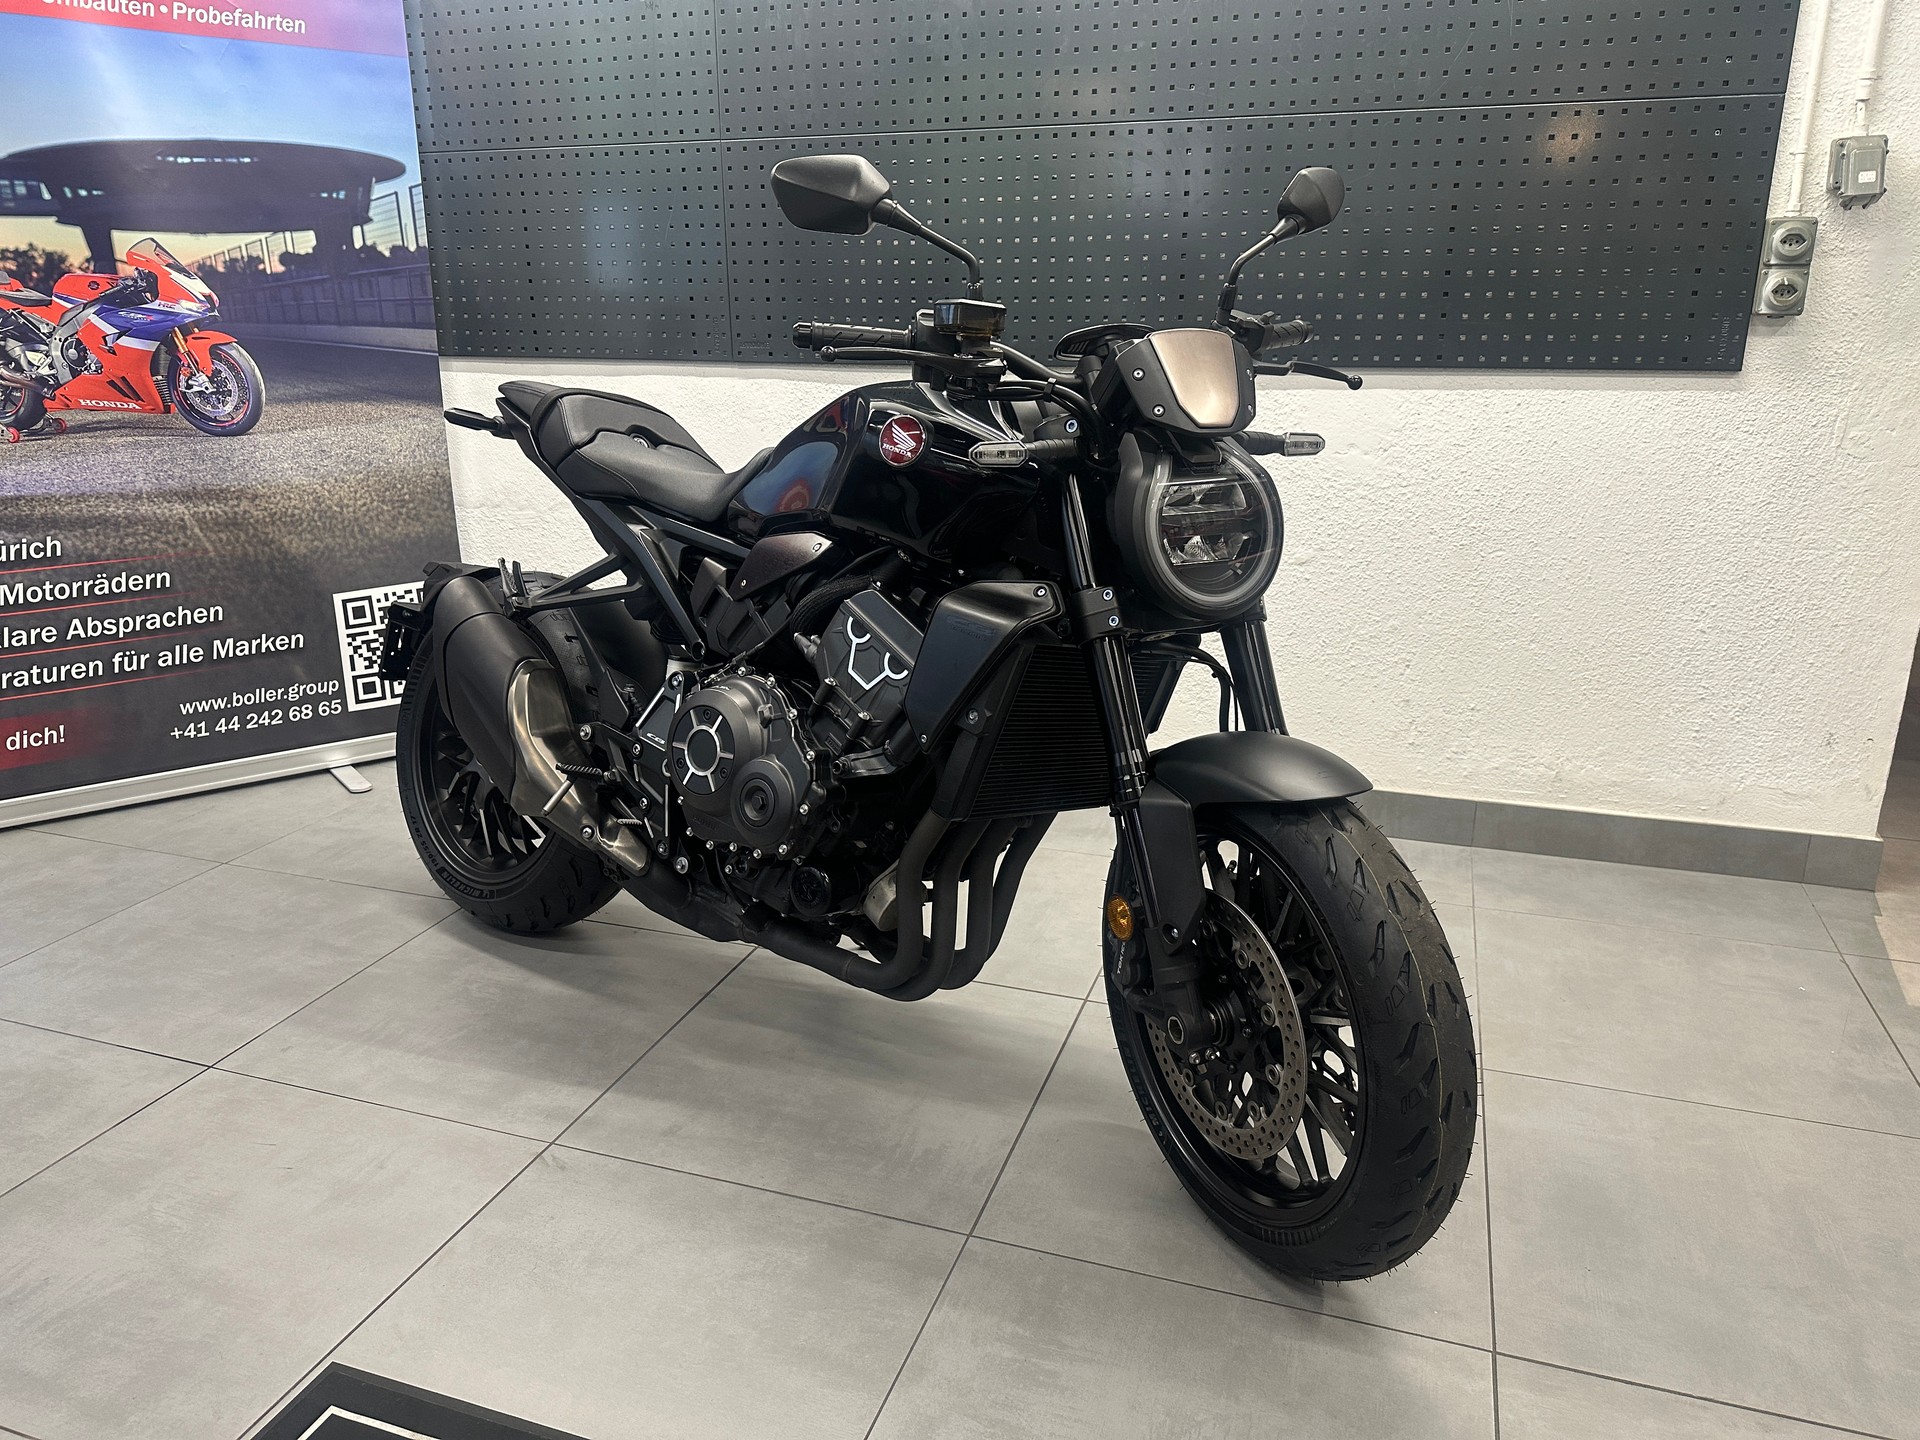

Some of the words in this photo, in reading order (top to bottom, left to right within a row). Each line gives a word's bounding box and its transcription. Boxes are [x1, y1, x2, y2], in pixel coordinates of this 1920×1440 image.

[172, 2, 306, 34] Probefahrten
[78, 398, 143, 410] HONDA
[882, 443, 912, 458] HONDA
[0, 571, 171, 606] Motorrädern
[0, 626, 58, 649] lare
[66, 605, 223, 640] Absprachen
[1, 660, 103, 689] raturen
[112, 651, 150, 674] für
[157, 643, 204, 667] alle
[213, 633, 304, 660] Marken
[179, 679, 339, 715] www.boller.group
[170, 721, 210, 739] +41
[215, 715, 241, 734] 44
[246, 709, 283, 729] 242
[288, 704, 313, 721] 68
[318, 699, 342, 717] 65
[6, 724, 65, 751] dich!
[441, 870, 481, 897] MICHELIN
